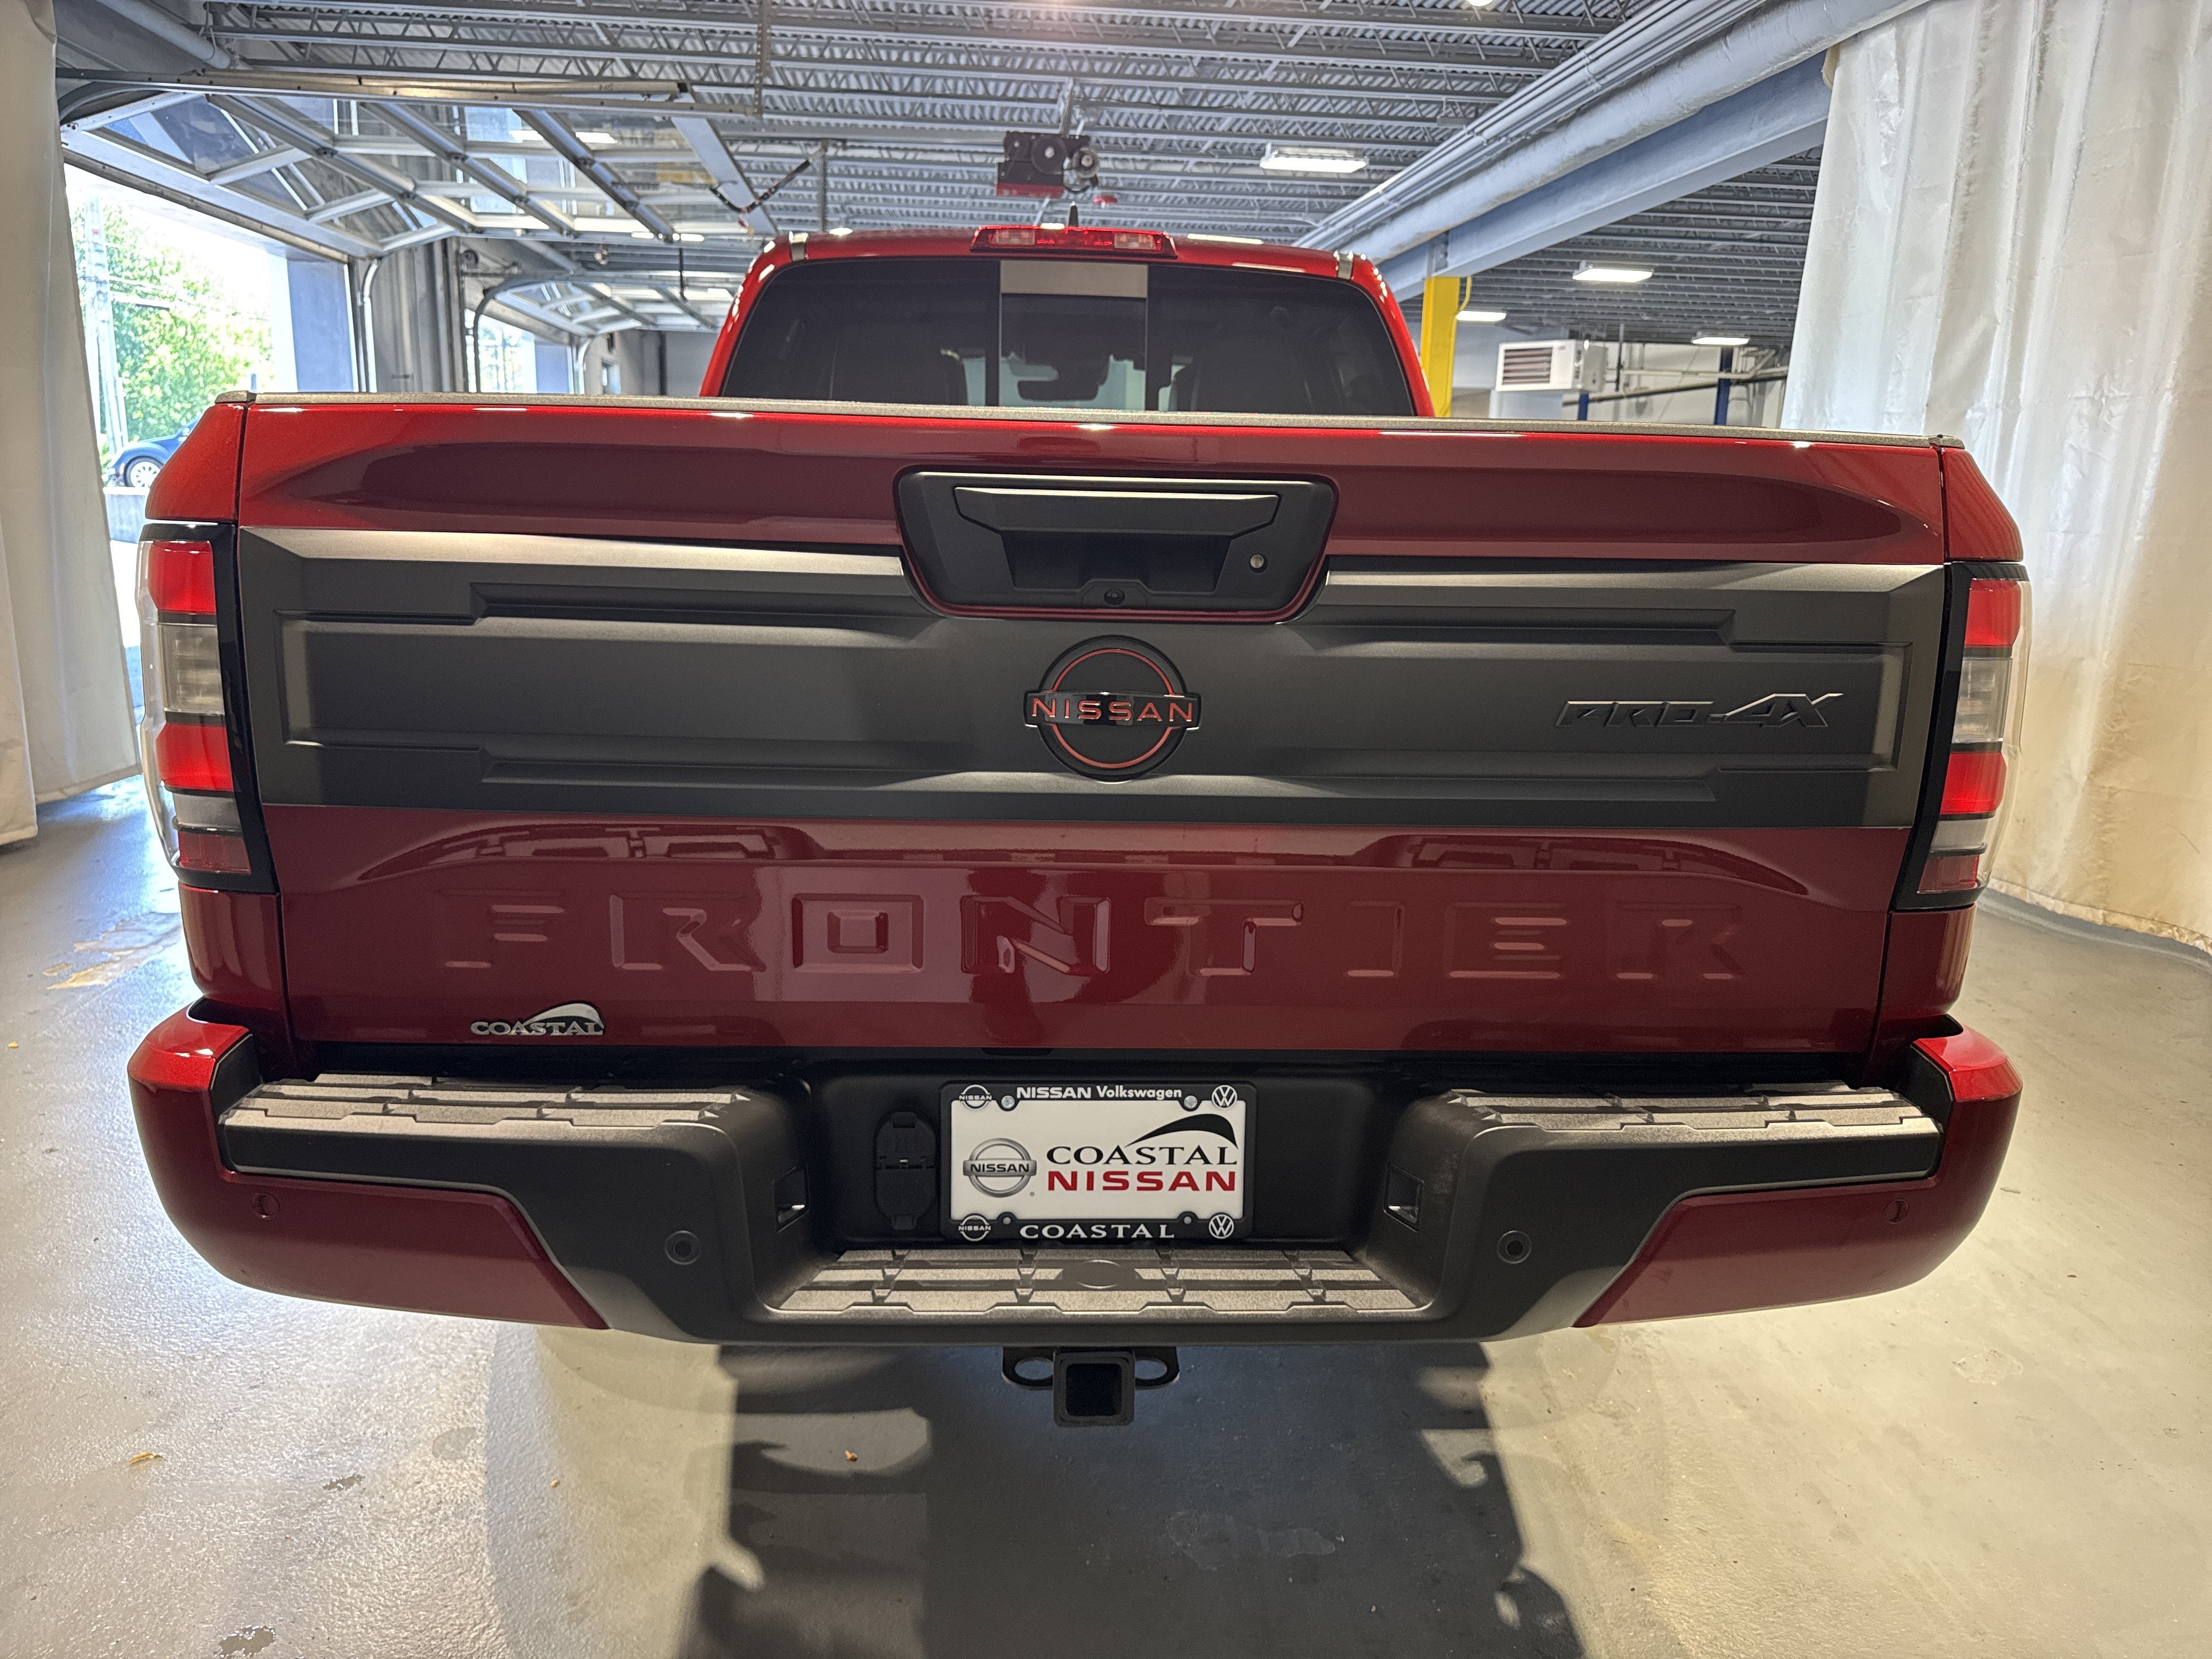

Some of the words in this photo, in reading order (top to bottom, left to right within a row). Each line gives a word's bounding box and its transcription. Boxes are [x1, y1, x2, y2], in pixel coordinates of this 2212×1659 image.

[1031, 697, 1192, 722] NISSAN
[1555, 692, 1844, 727] PRO-4X
[437, 889, 1745, 981] FRONTIER
[470, 1020, 603, 1036] COASTAL
[1016, 1086, 1092, 1099] NISSAN
[1096, 1085, 1182, 1101] Volkswagen
[1046, 1144, 1238, 1165] COASTAL
[970, 1163, 1030, 1173] NISSAN
[1047, 1170, 1236, 1192] NISSAN
[1019, 1223, 1175, 1239] COASTAL
